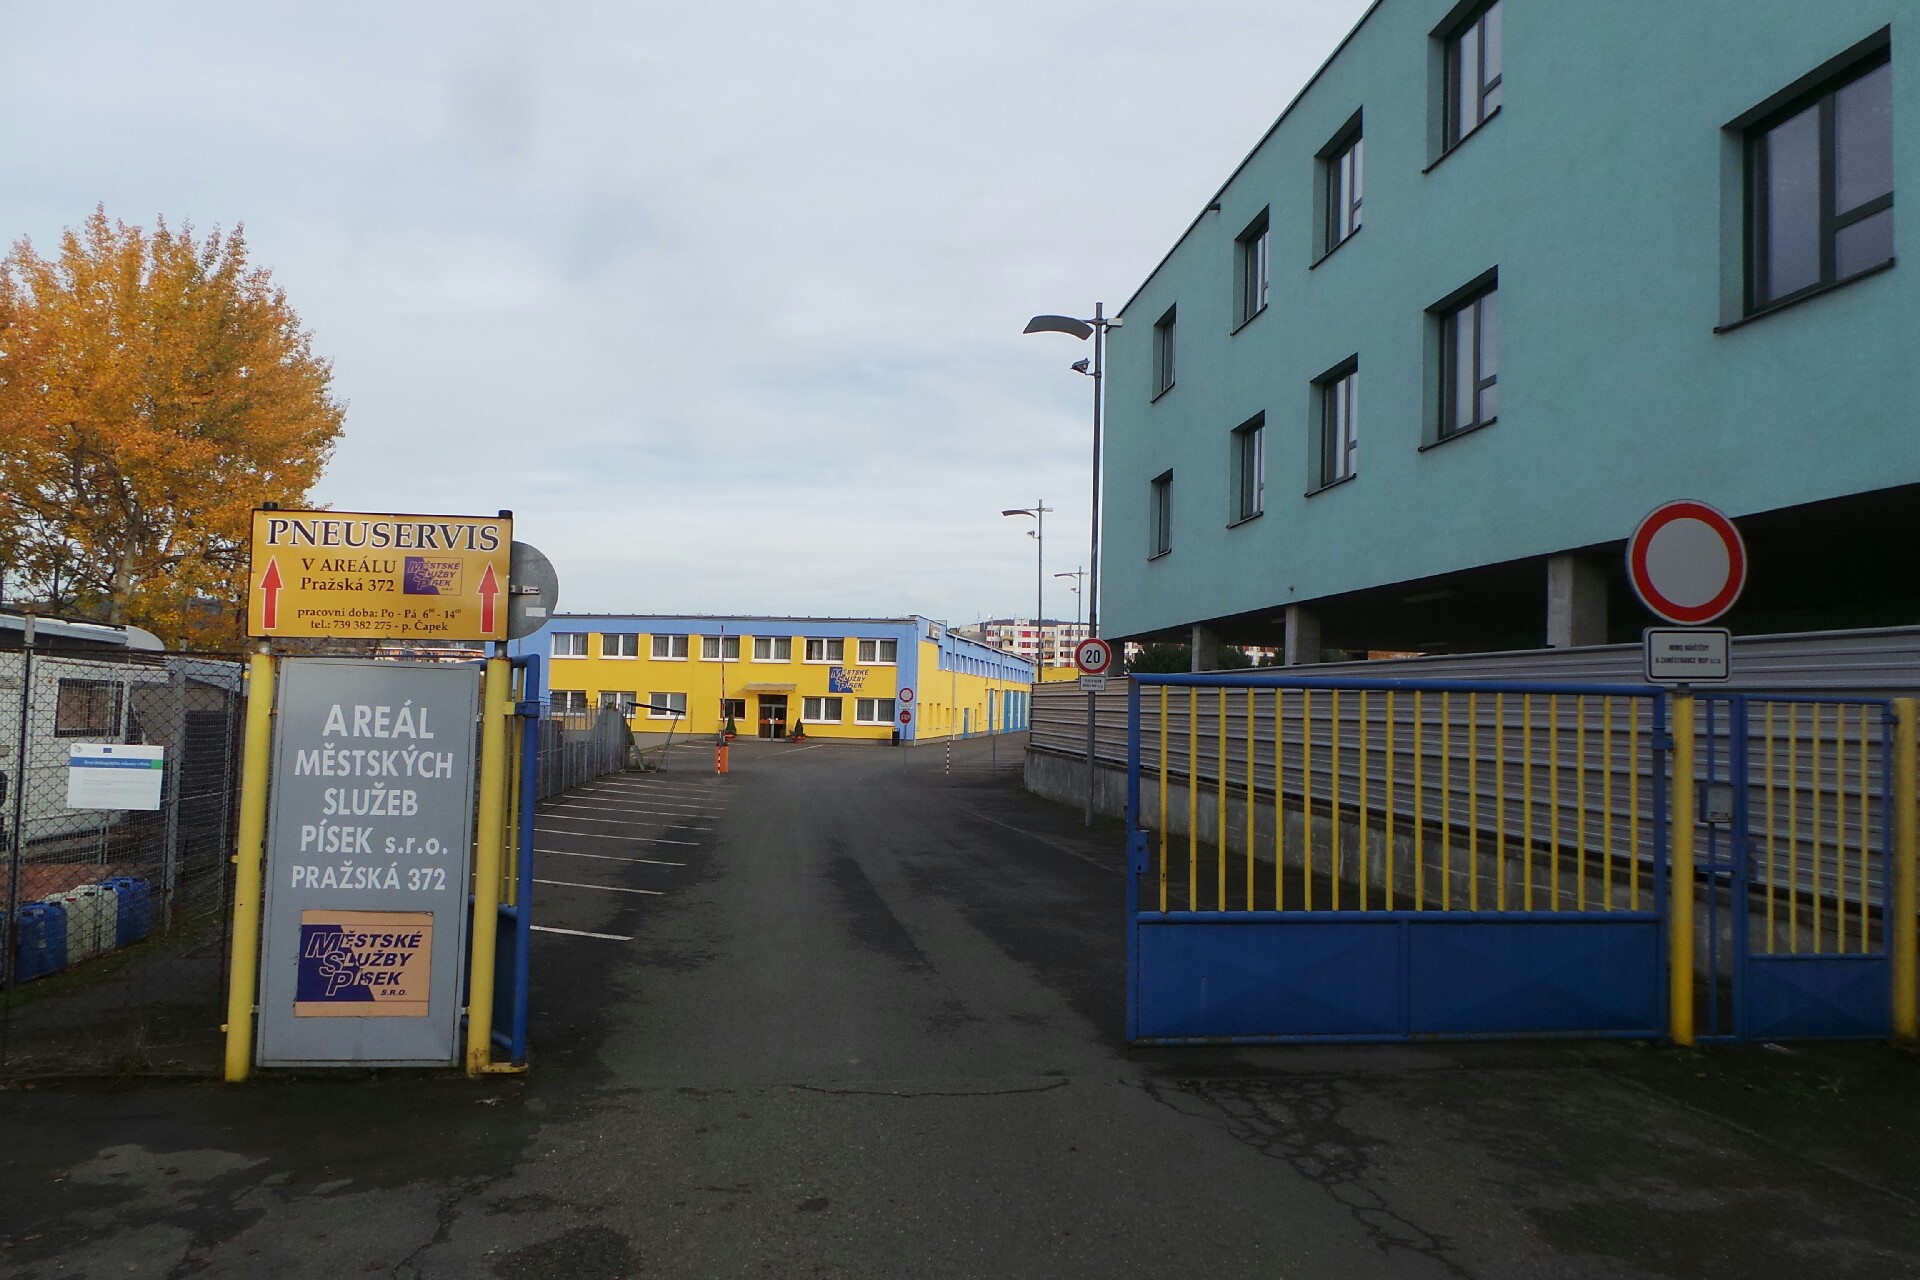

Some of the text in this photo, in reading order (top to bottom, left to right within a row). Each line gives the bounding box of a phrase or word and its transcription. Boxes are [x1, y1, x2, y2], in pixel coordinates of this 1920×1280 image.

[266, 518, 500, 552] PNEUSERVIS
[301, 556, 397, 574] V AREÁLU
[301, 578, 395, 593] Pražská 372
[297, 607, 345, 619] pracovní
[348, 608, 378, 618] doba:
[381, 608, 394, 618] Po
[404, 608, 417, 619] Pá
[311, 620, 331, 629] tel.:
[333, 620, 351, 630] 739
[354, 620, 371, 630] 382
[374, 621, 392, 630] 275
[401, 623, 411, 633] p.
[414, 620, 448, 633] Čapek
[1085, 649, 1101, 664] 20
[322, 699, 434, 739] AREÁL
[294, 742, 453, 779] MĚSTSKÝCH
[323, 782, 419, 816] SLUŽEB
[300, 818, 448, 855] PÍSEK s.r.o.
[291, 861, 446, 890] PRAŽSKÁ 372
[305, 931, 423, 958] MĚSTSKÉ
[319, 951, 413, 977] SLUŽBY
[380, 988, 407, 997] S.R.O.
